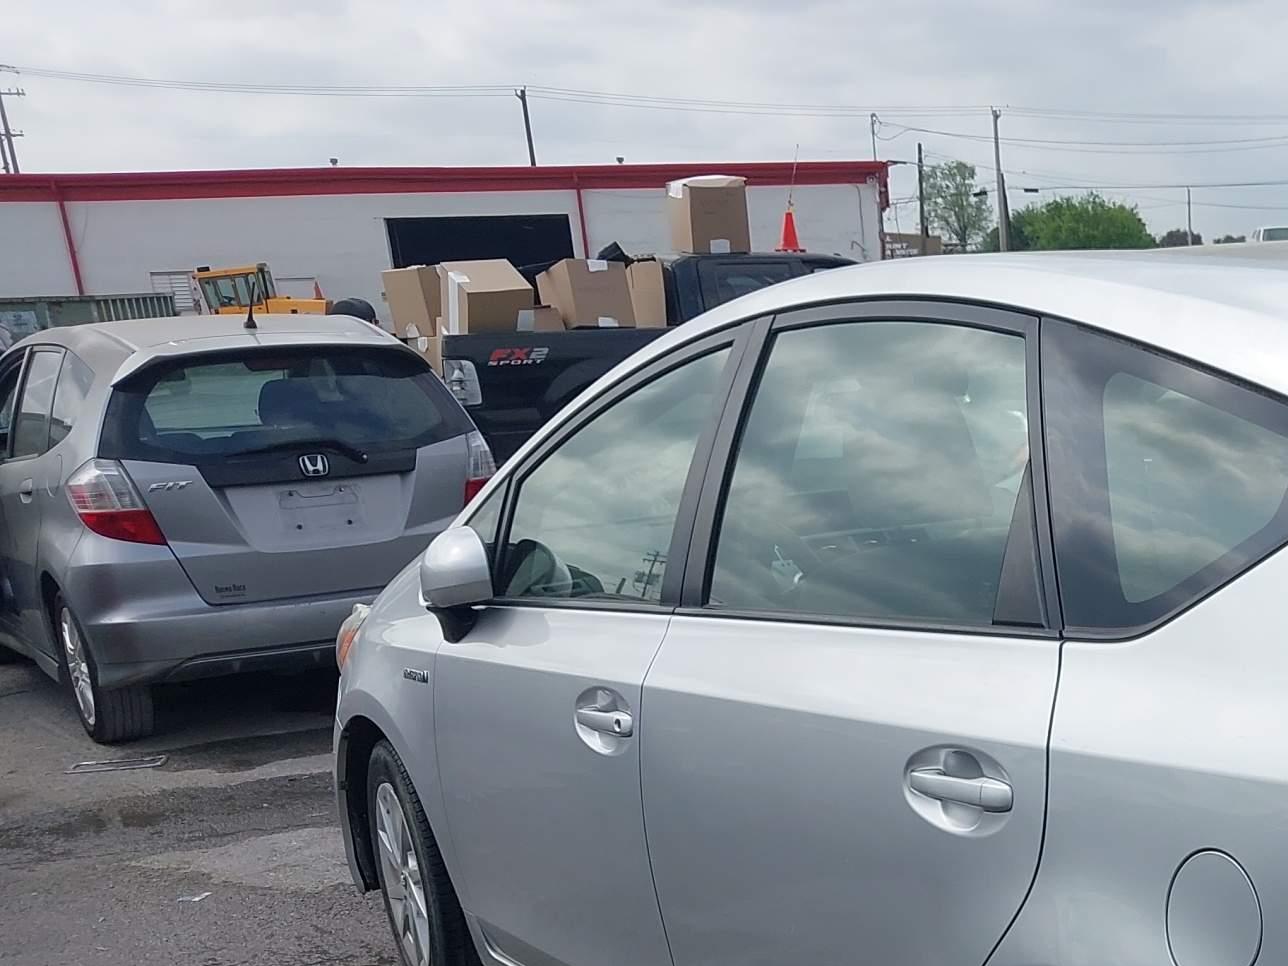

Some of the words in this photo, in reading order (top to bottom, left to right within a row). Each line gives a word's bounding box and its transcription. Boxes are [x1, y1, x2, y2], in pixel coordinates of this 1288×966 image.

[489, 347, 550, 362] FX2
[487, 359, 545, 367] SPORT
[148, 480, 193, 492] FIT
